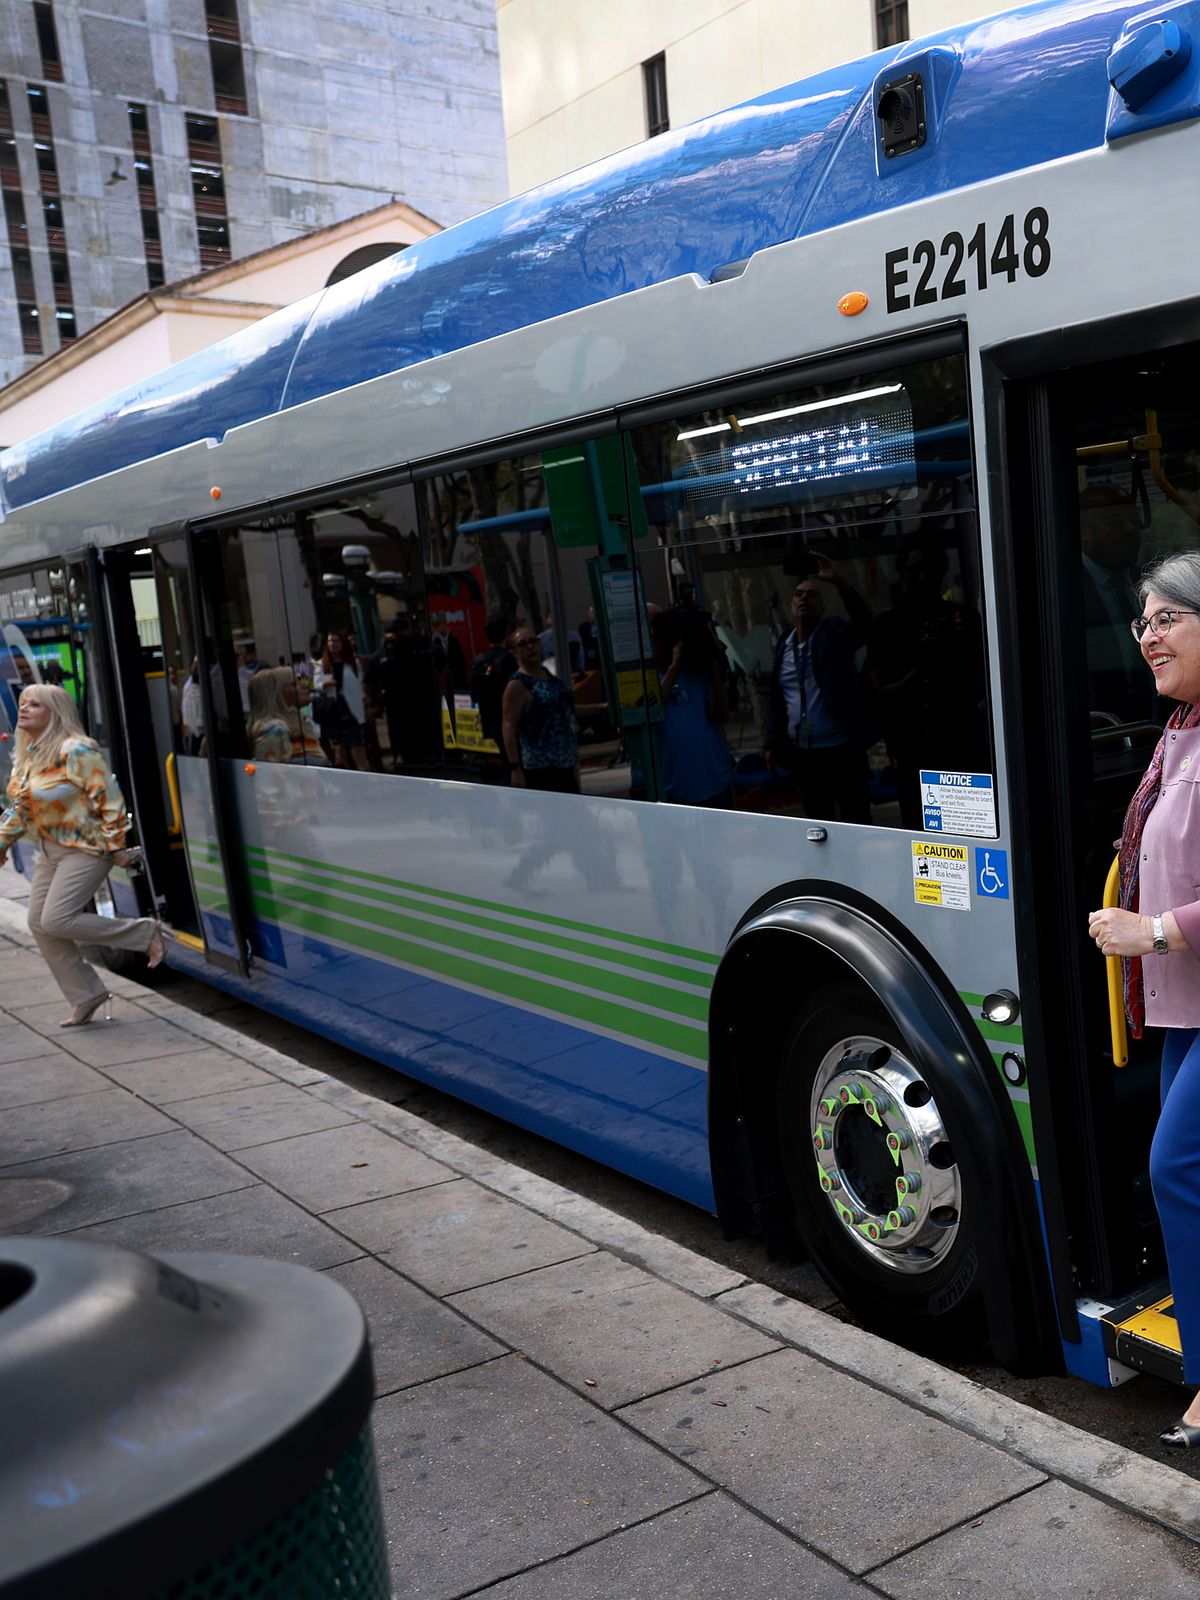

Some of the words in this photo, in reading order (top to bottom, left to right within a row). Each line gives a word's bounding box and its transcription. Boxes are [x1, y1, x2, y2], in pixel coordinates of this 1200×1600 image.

[885, 206, 1051, 314] E22148
[940, 774, 972, 786] NOTICE
[924, 808, 941, 816] AVISO
[923, 845, 963, 859] CAUTION
[931, 860, 949, 870] STAND
[949, 862, 966, 871] CLEAR
[936, 869, 945, 878] Bus
